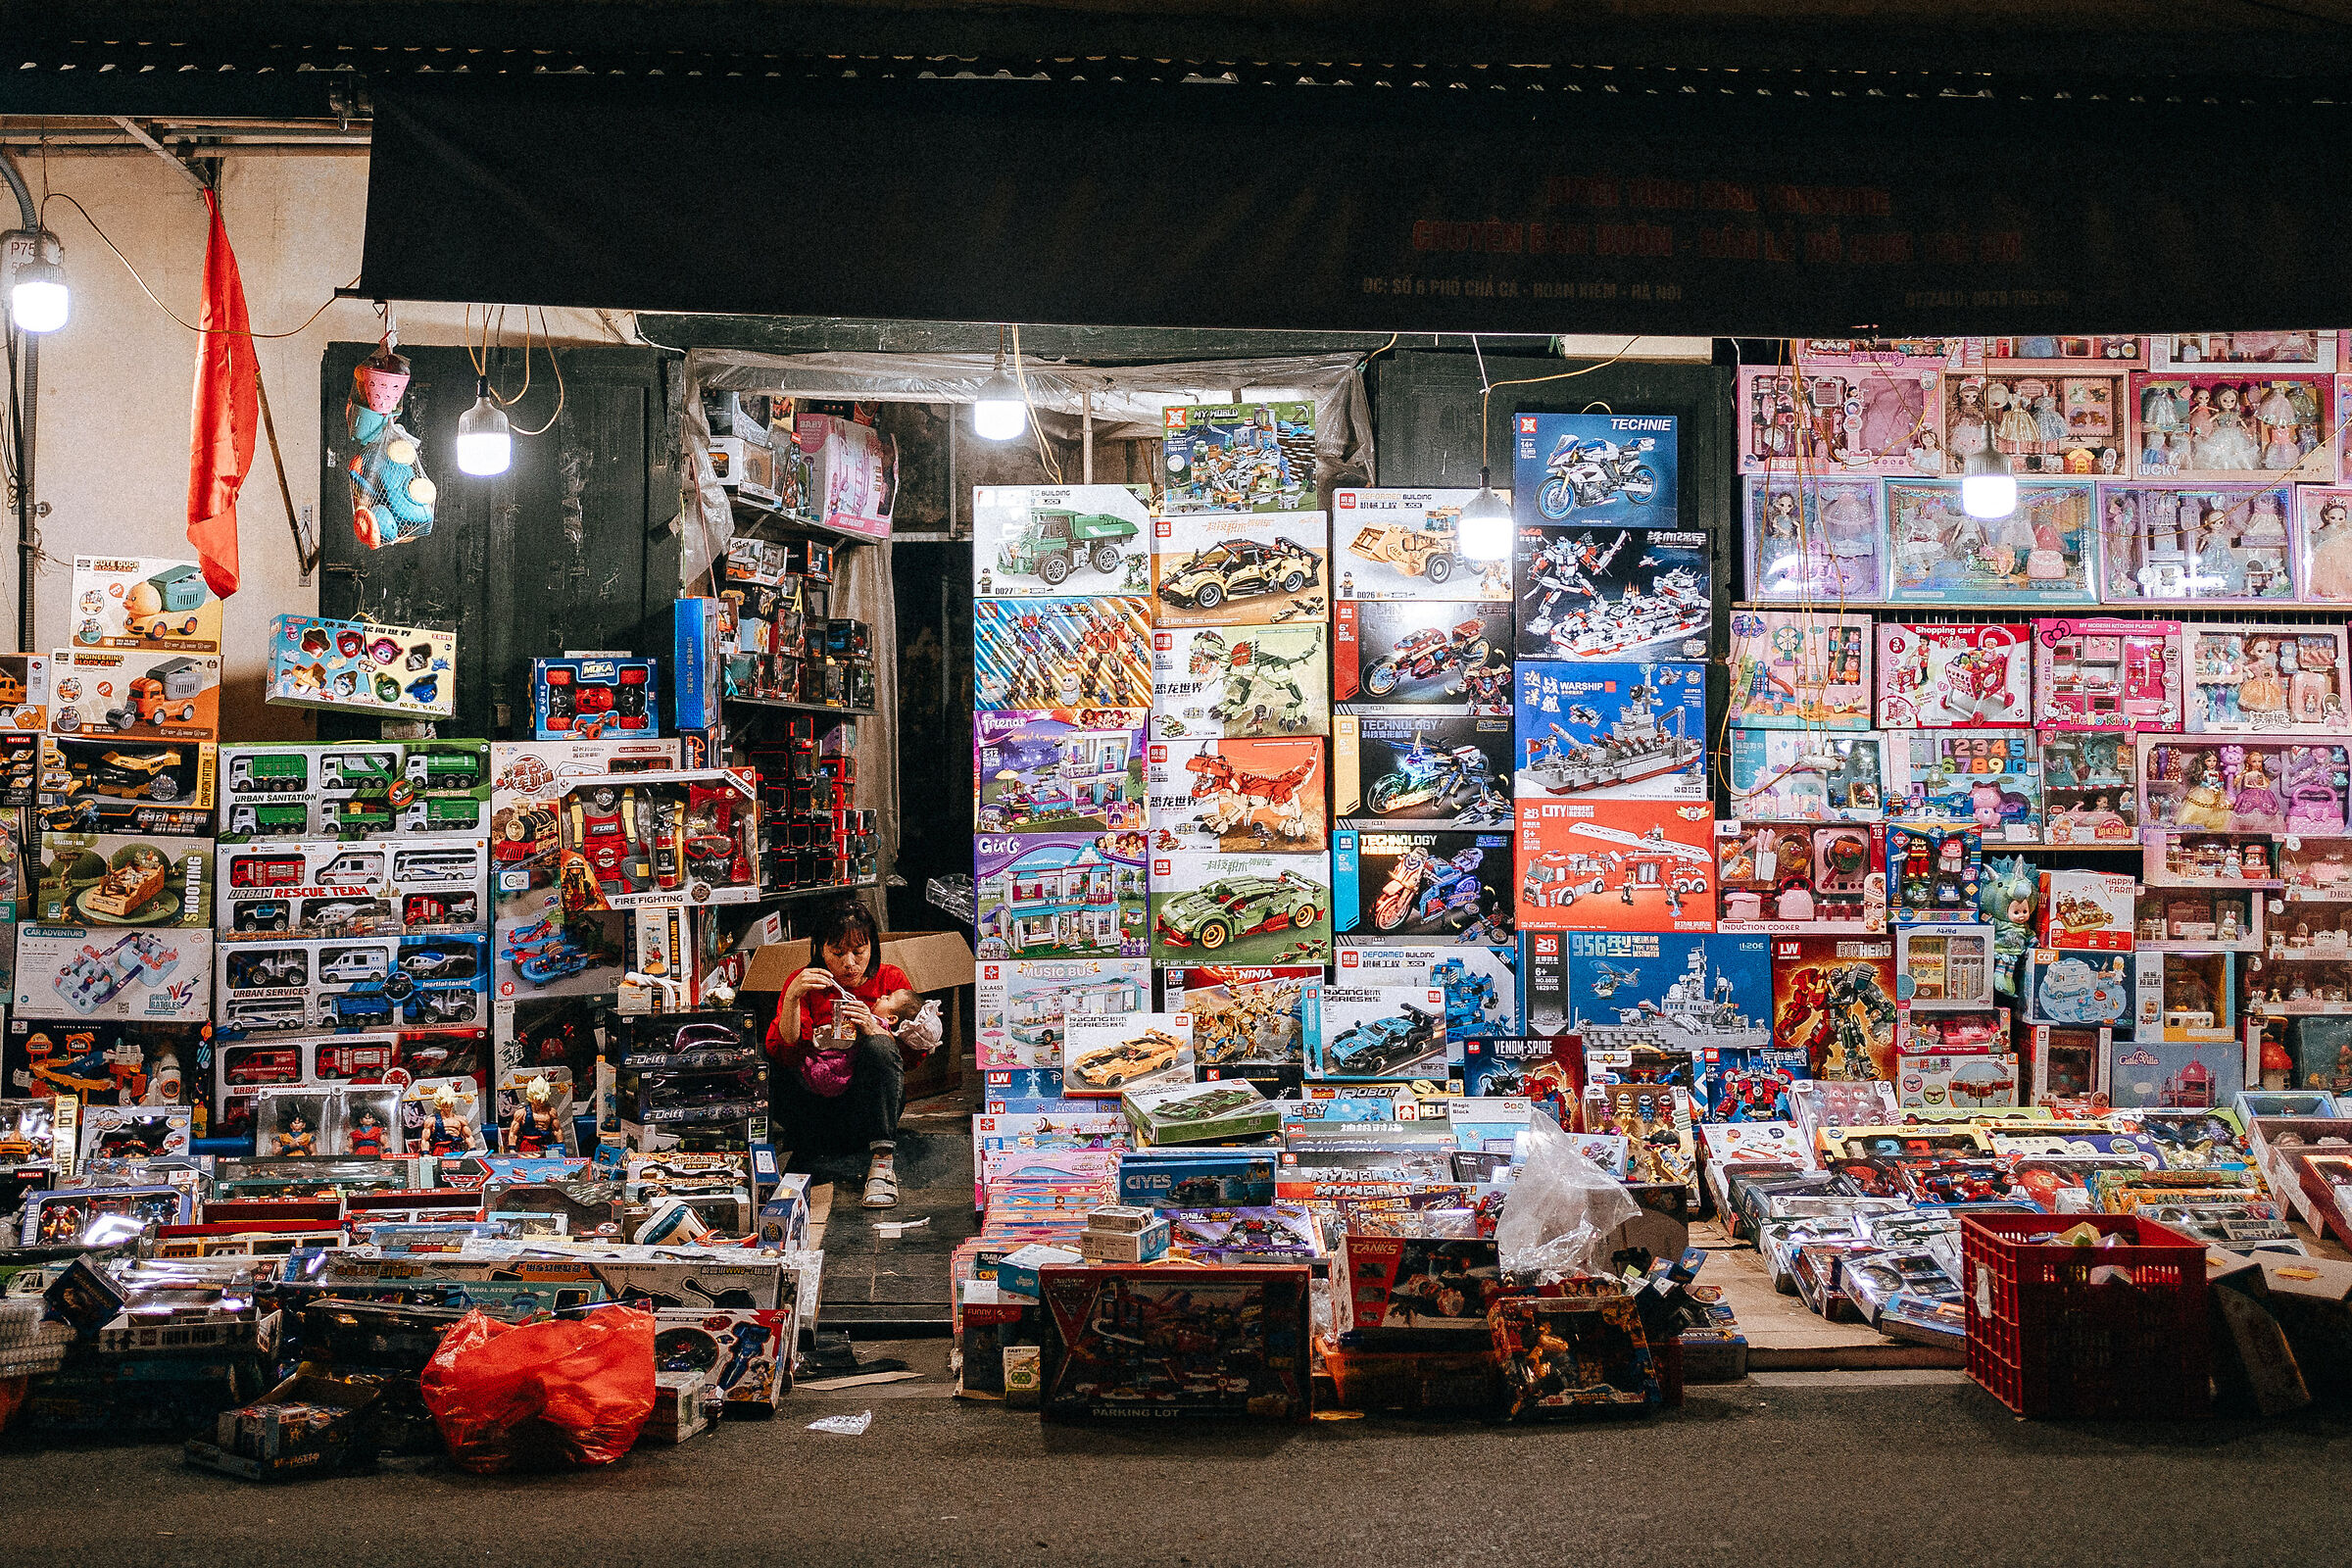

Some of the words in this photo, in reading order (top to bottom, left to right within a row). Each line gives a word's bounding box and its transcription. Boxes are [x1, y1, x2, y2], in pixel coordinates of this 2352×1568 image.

[1610, 418, 1672, 431] TECHNIE
[2137, 464, 2180, 477] LUCKY
[94, 560, 116, 568] CUTE
[118, 561, 139, 569] DUCK
[1915, 625, 1956, 636] Shopping
[1957, 626, 1976, 635] cart
[1938, 636, 1968, 649] Kids
[74, 653, 124, 662] ENGINEERING
[1154, 682, 1202, 695] 恐龙世界
[1559, 681, 1603, 691] WARSHIP
[1361, 720, 1438, 731] TECHNOLOGY
[2070, 712, 2103, 726] Hello
[2105, 712, 2138, 728] Kitty
[1941, 739, 1951, 757] 1
[1954, 739, 1971, 757] 2
[1972, 739, 1988, 757] 3
[1989, 739, 2007, 757] 4
[2009, 739, 2026, 757] 5
[1941, 759, 1955, 775] 6
[1956, 759, 1971, 775] 7
[1972, 759, 1988, 775] 8
[1988, 759, 2005, 775] 9
[2005, 759, 2027, 775] 10
[234, 795, 264, 804] URBAN
[267, 794, 317, 804] SANITATION
[1150, 796, 1198, 808] 恐龙世界
[1542, 806, 1567, 818] CITY
[978, 838, 1020, 855] Girls
[2105, 877, 2133, 886] HAPPY
[184, 857, 202, 922] SHOOTING
[227, 889, 273, 900] URBAN
[273, 887, 326, 899] RESCUE
[330, 885, 369, 897] TEAM
[2109, 886, 2133, 895] FARM
[614, 896, 635, 905] FIRE
[639, 894, 683, 904] FIGHTING
[1780, 944, 1799, 955] LW
[2037, 952, 2056, 960] car
[1023, 966, 1066, 978] MUSIC
[1068, 966, 1096, 978] BUS
[1238, 968, 1274, 980] NINJA
[1535, 967, 1547, 976] 6+
[233, 989, 264, 998] URBAN
[266, 988, 310, 998] SERVICES
[991, 1073, 1010, 1084] LW
[1338, 1087, 1400, 1099] ROBOT
[1126, 1174, 1172, 1190] CIYES
[1352, 1243, 1398, 1254] TANKS
[967, 1307, 991, 1316] FUNNY
[1093, 1408, 1151, 1418] PARKING
[1154, 1408, 1180, 1418] LOT
